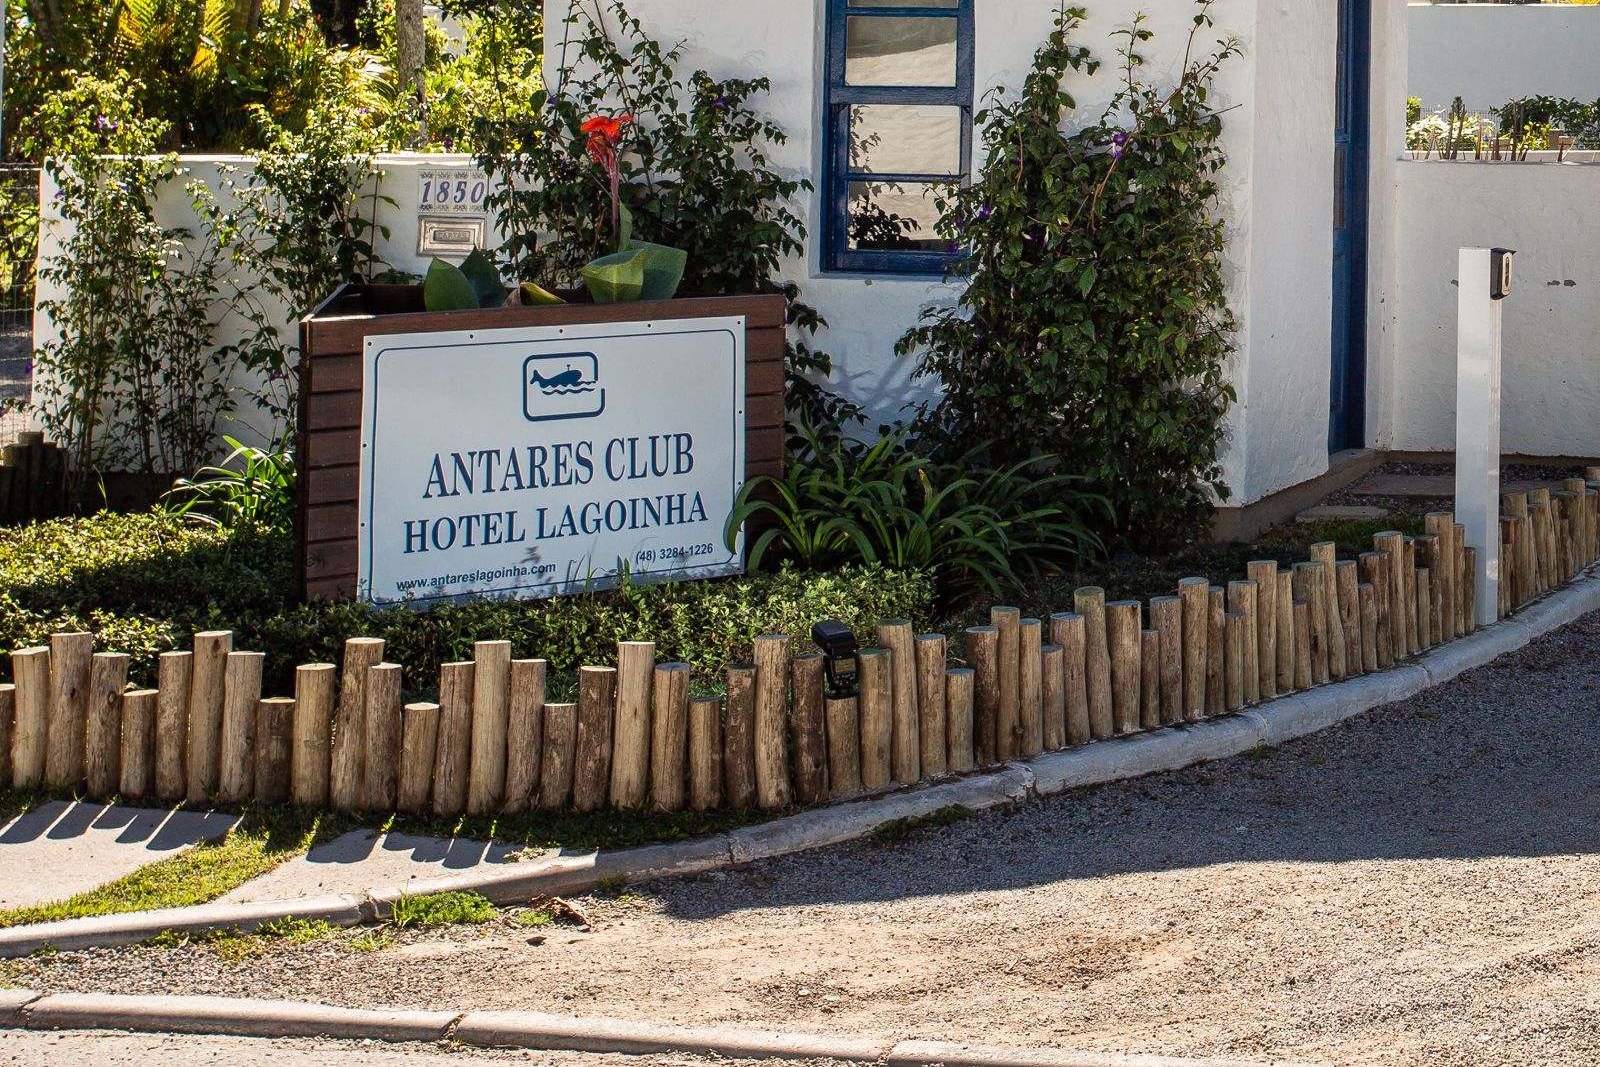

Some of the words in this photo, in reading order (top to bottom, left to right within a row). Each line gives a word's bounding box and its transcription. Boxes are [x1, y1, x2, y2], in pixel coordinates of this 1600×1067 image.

[422, 181, 485, 203] 1850
[422, 440, 594, 499] ANTARES
[604, 432, 695, 483] CLUB
[402, 510, 526, 554] HOTEL
[535, 490, 708, 540] LAGOINHA
[635, 550, 657, 564] (48)
[659, 542, 714, 560] 3284-1226
[396, 563, 556, 591] www.antareslagoinha.com
